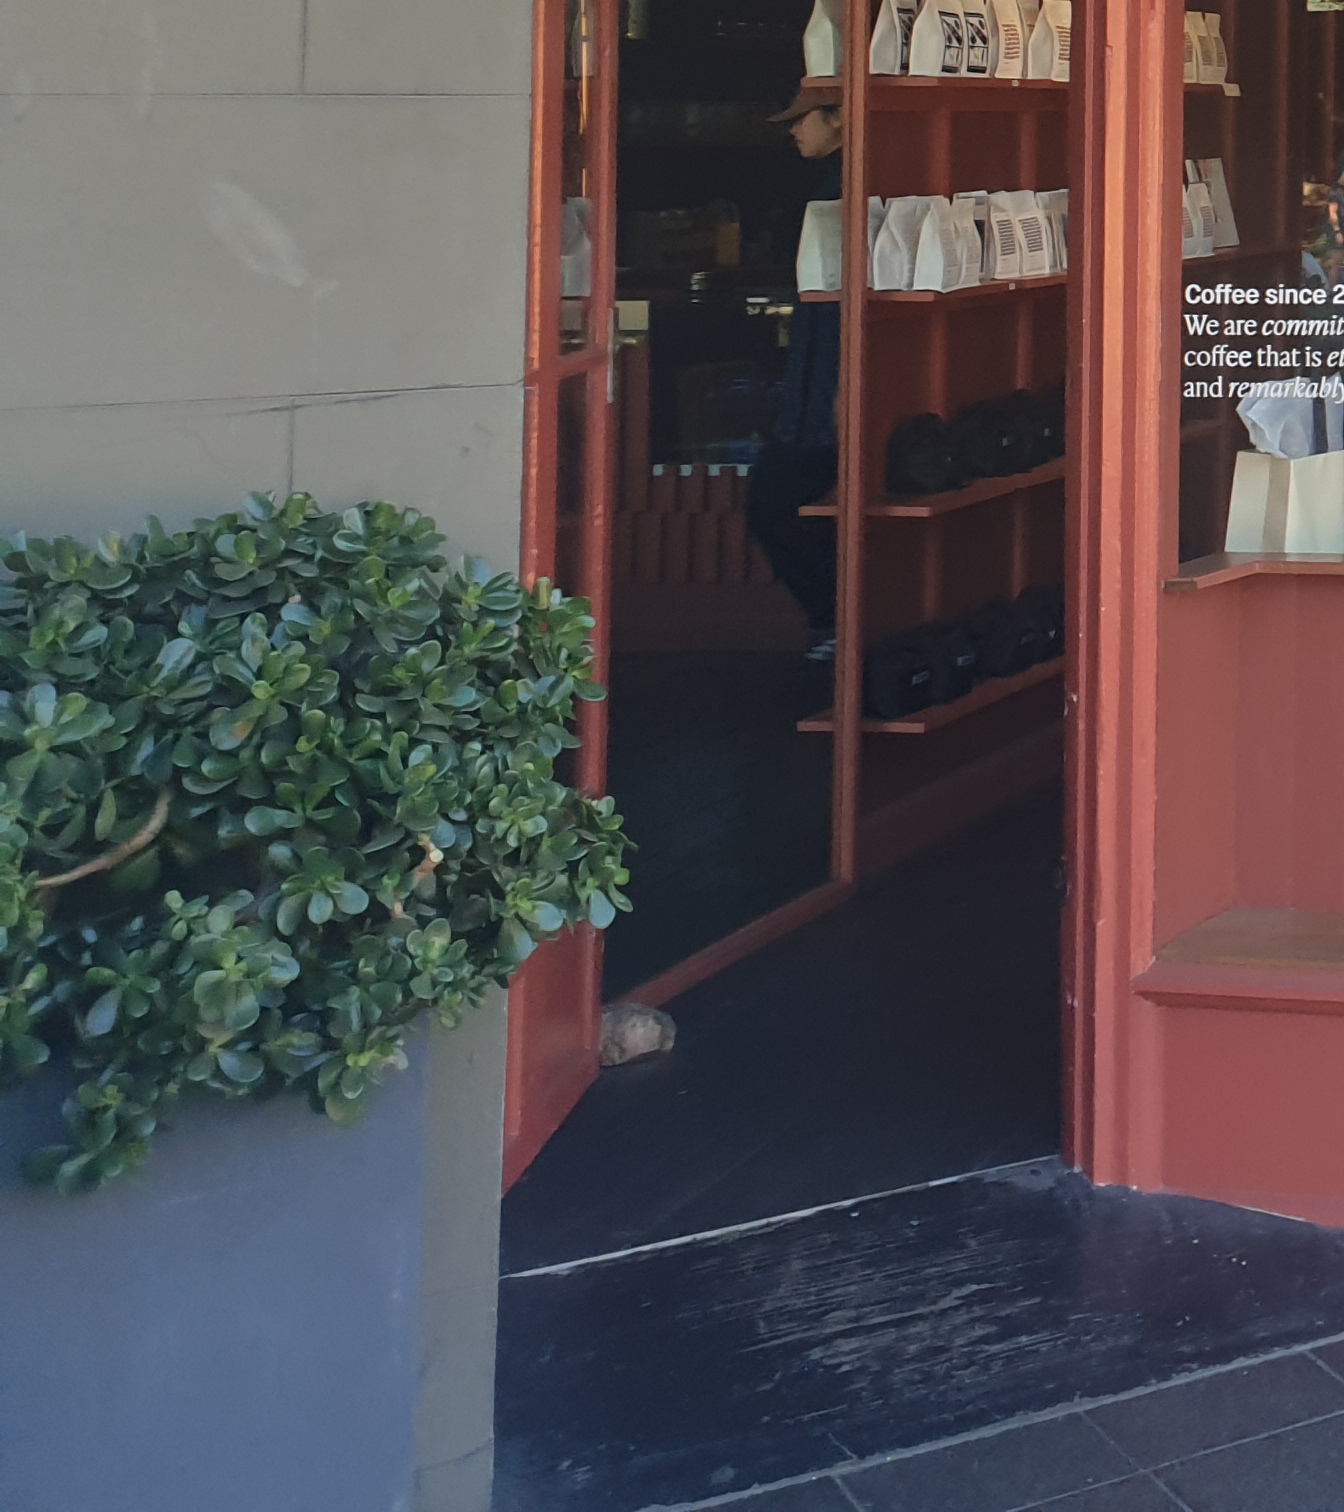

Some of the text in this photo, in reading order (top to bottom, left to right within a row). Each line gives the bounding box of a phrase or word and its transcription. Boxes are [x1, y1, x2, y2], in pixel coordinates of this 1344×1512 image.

[1184, 283, 1260, 305] Coffee
[1264, 283, 1328, 305] since
[1184, 314, 1220, 336] We
[1223, 319, 1258, 336] are
[1183, 344, 1252, 368] coffee
[1256, 345, 1301, 368] that
[1304, 346, 1323, 368] is
[1183, 376, 1223, 399] and
